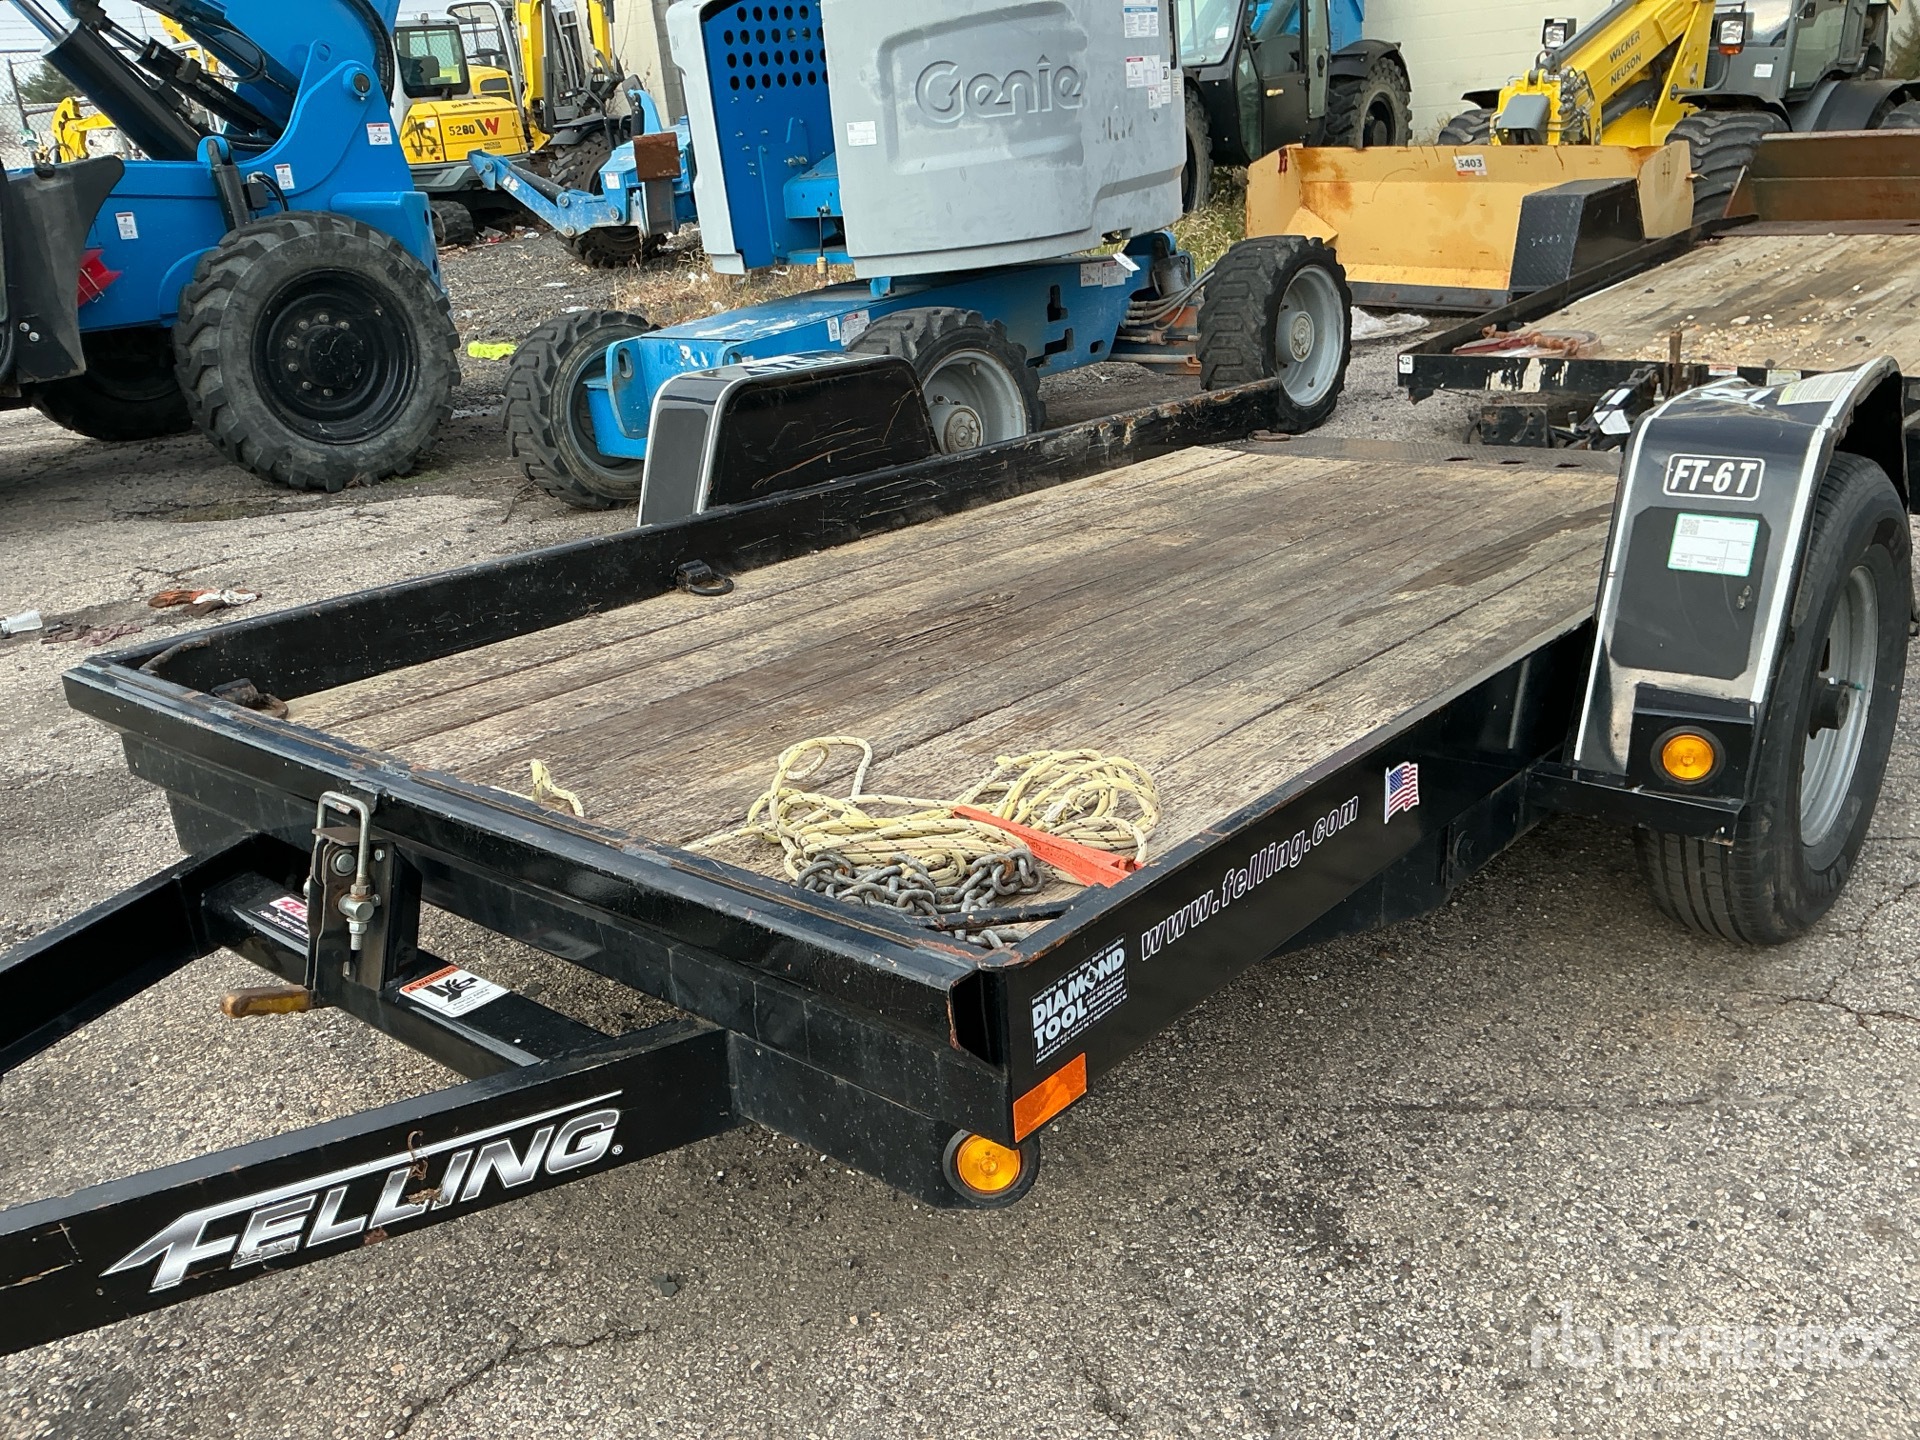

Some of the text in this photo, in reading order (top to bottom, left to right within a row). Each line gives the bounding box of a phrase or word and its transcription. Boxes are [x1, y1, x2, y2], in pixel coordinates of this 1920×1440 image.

[1609, 31, 1642, 63] WACKER
[1610, 52, 1642, 86] NEUSON
[915, 53, 1084, 124] Genie
[1458, 158, 1483, 169] 5403
[1141, 796, 1360, 961] www.felling.com
[1032, 947, 1125, 1029] DIAMOND
[1034, 996, 1088, 1050] TOOL
